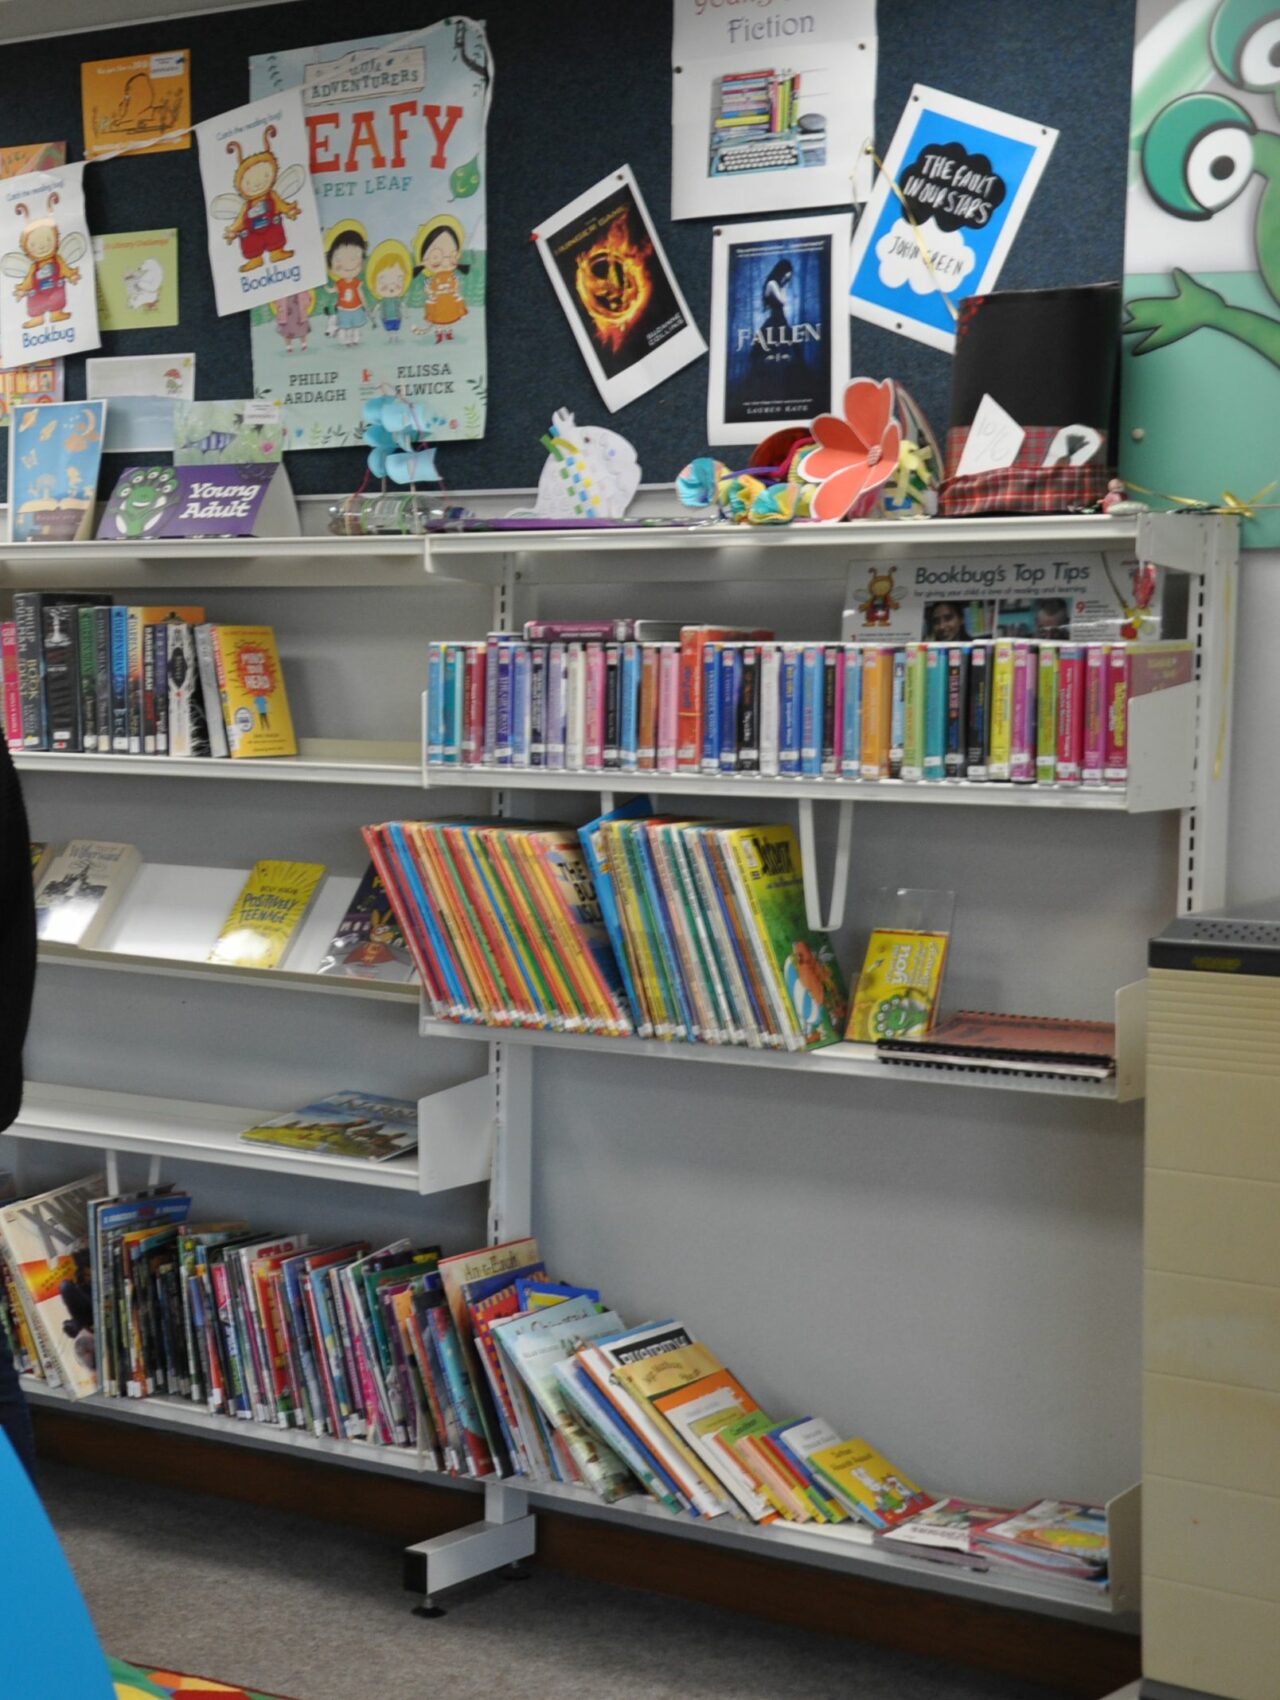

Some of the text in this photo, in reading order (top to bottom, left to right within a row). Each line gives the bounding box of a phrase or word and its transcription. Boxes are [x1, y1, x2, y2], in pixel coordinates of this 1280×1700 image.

[727, 14, 816, 44] Fiction
[311, 68, 420, 98] ADVENTURERS
[304, 99, 465, 175] EAFY
[322, 174, 413, 199] PET LEAF
[922, 154, 998, 198] THE FAULT
[903, 175, 993, 224] IN OUR STARS
[240, 265, 302, 294] Bookbug
[22, 326, 76, 349] Bookbug
[736, 322, 823, 352] FALLEN
[288, 362, 452, 388] PHILIP ELISSA
[283, 388, 348, 405] ARDAGH
[188, 482, 261, 502] Young
[178, 500, 252, 519] Adult
[914, 561, 1090, 587] Bookbug's Top Tips
[15, 600, 26, 652] PULLMAN
[25, 606, 36, 643] PHILIP
[28, 658, 39, 700] BOOK
